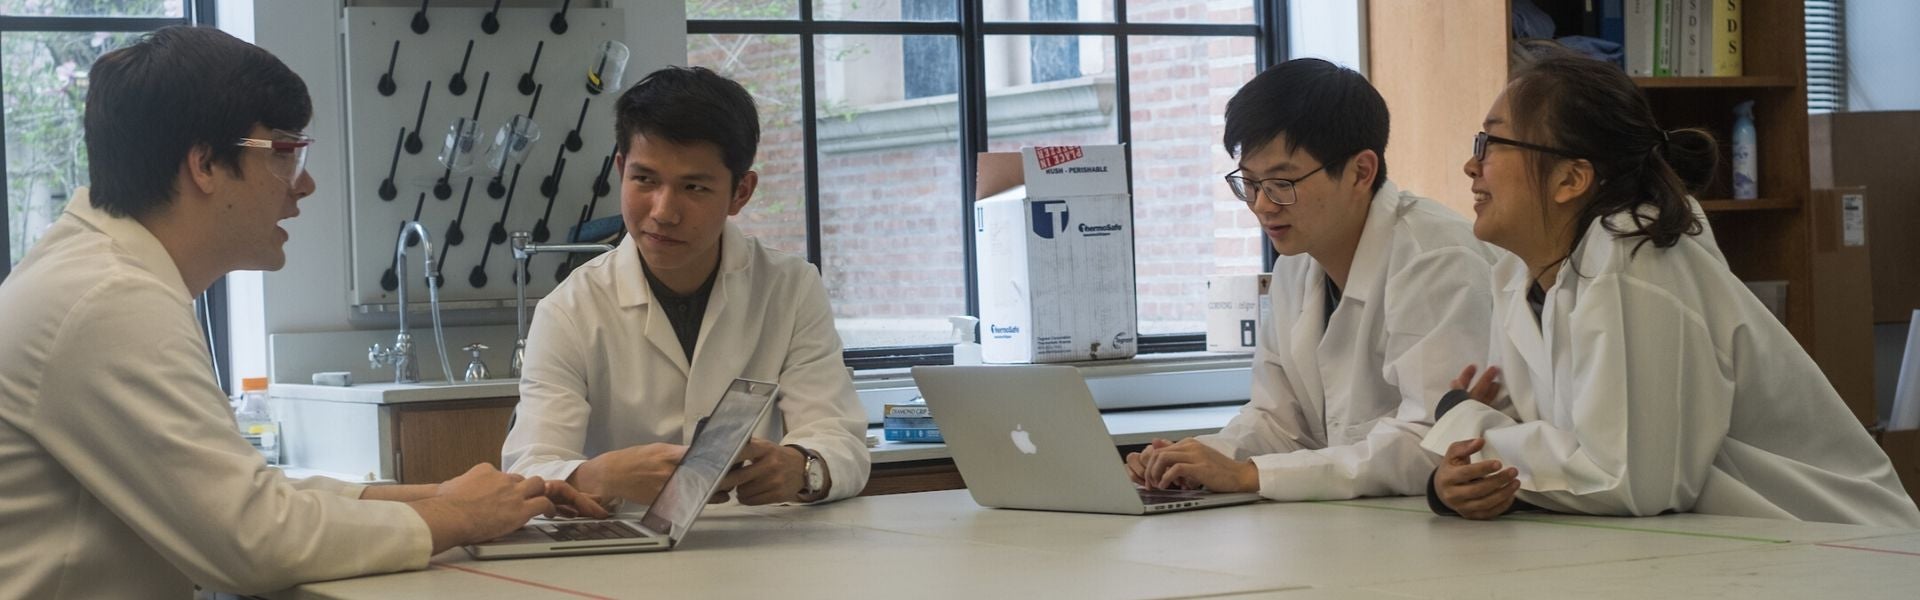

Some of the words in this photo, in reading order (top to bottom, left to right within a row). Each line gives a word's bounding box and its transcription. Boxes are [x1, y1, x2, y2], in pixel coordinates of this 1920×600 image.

[1053, 148, 1083, 165] PLACE
[1040, 159, 1051, 169] IN
[1068, 166, 1108, 174] PERISHABLE
